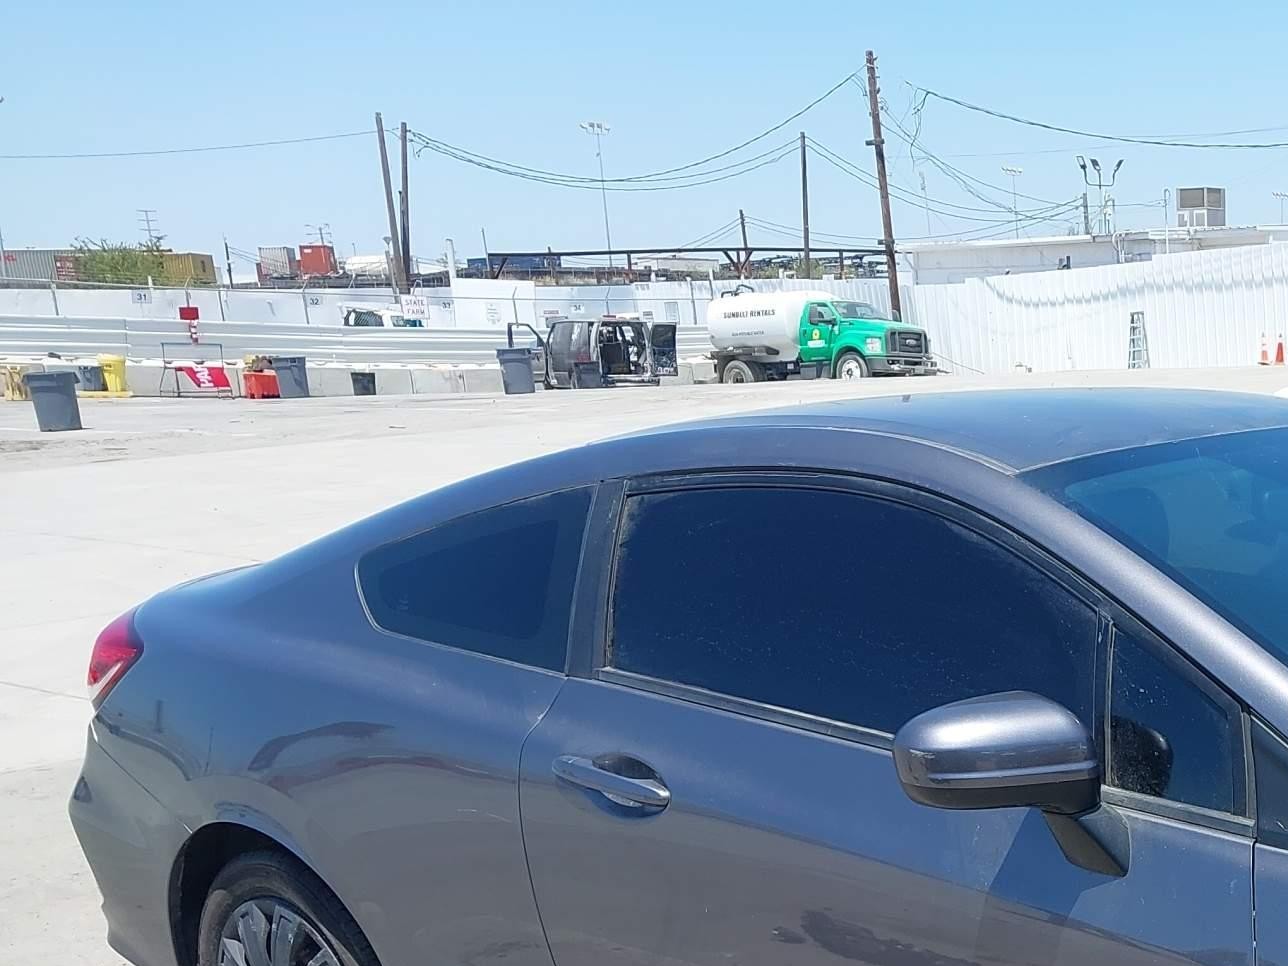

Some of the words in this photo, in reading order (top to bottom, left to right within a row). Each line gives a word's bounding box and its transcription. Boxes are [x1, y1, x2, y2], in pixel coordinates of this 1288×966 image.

[136, 292, 147, 301] 31
[310, 297, 319, 305] 32
[405, 298, 425, 306] STATE
[407, 307, 425, 315] FARM
